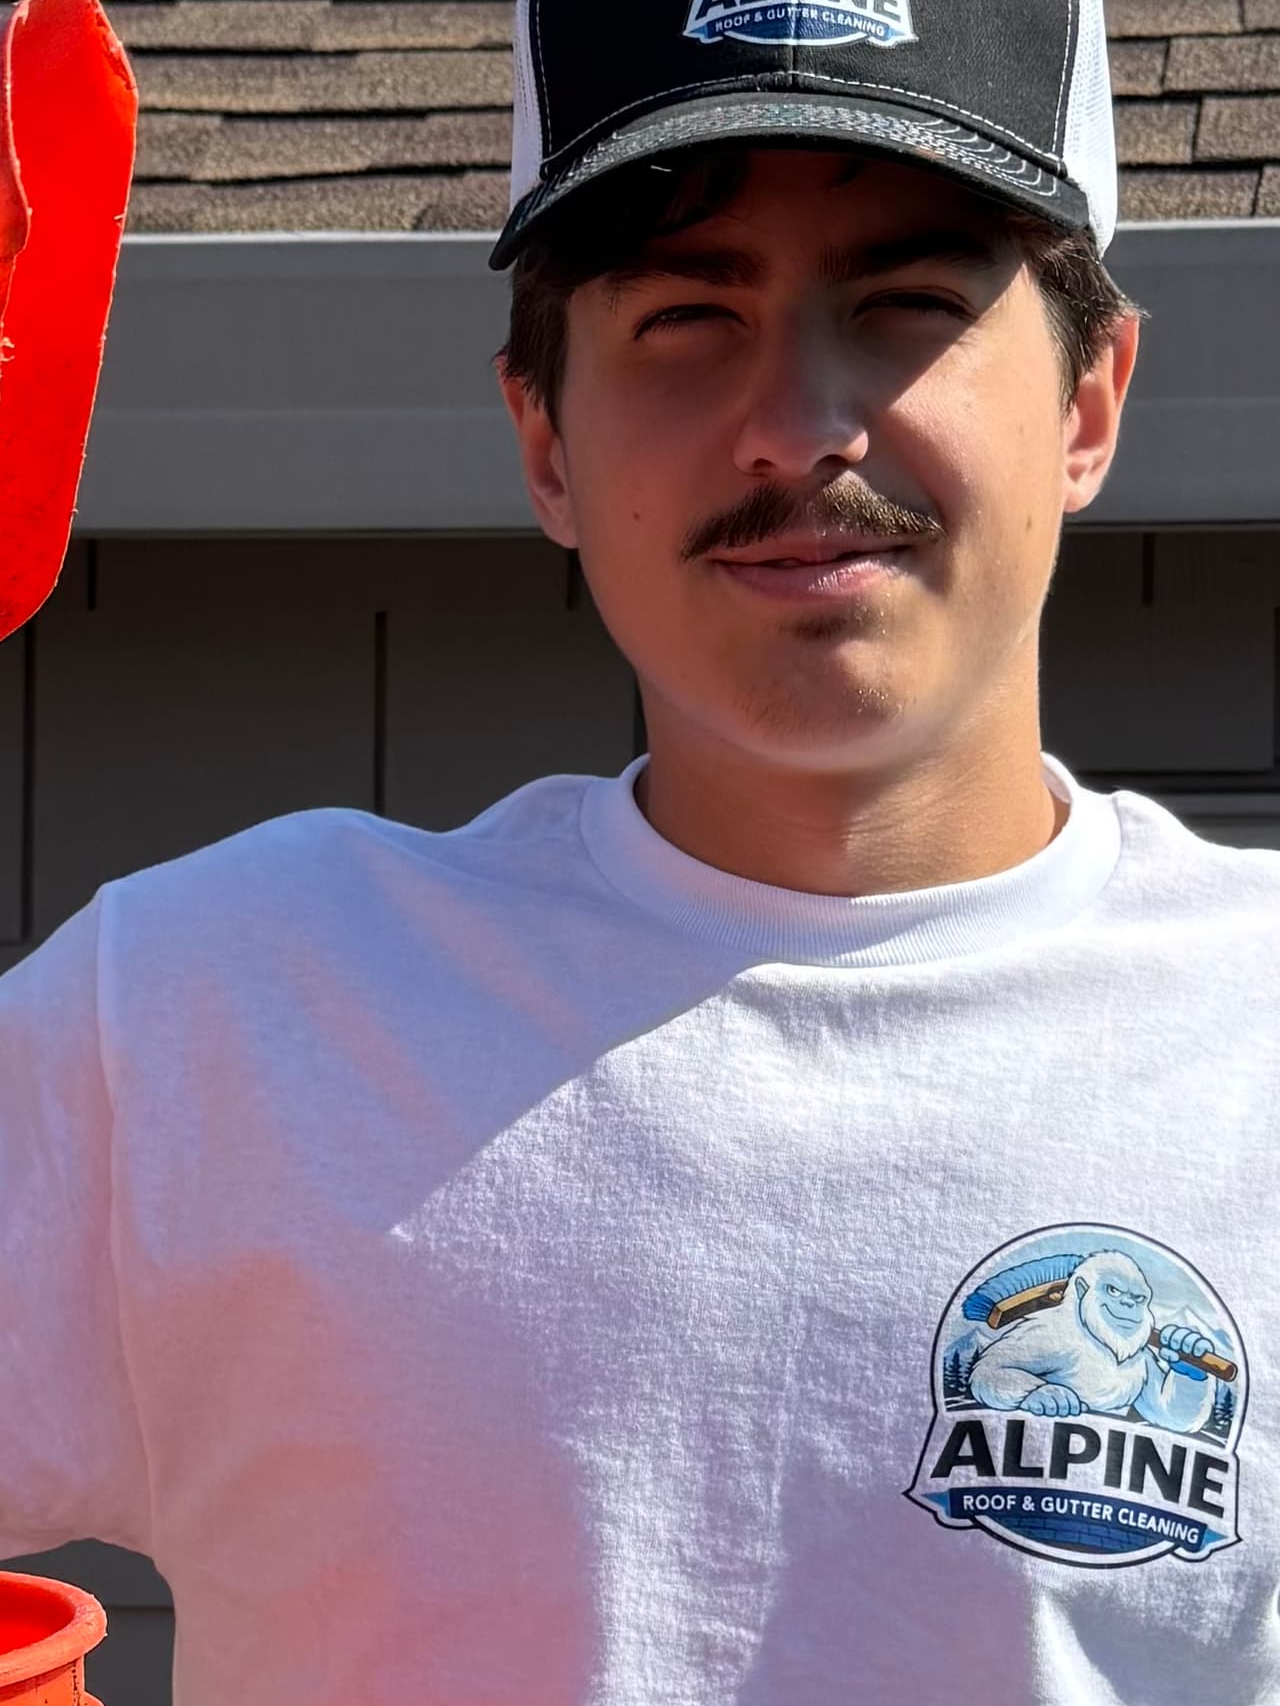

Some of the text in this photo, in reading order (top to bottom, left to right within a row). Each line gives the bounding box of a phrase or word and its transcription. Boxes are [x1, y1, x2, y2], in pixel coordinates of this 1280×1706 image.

[715, 6, 886, 38] ROOF & GUTTER CLEANING
[930, 1419, 1229, 1519] ALPINE
[962, 1495, 1200, 1544] ROOF & GUTTER CLEANING
